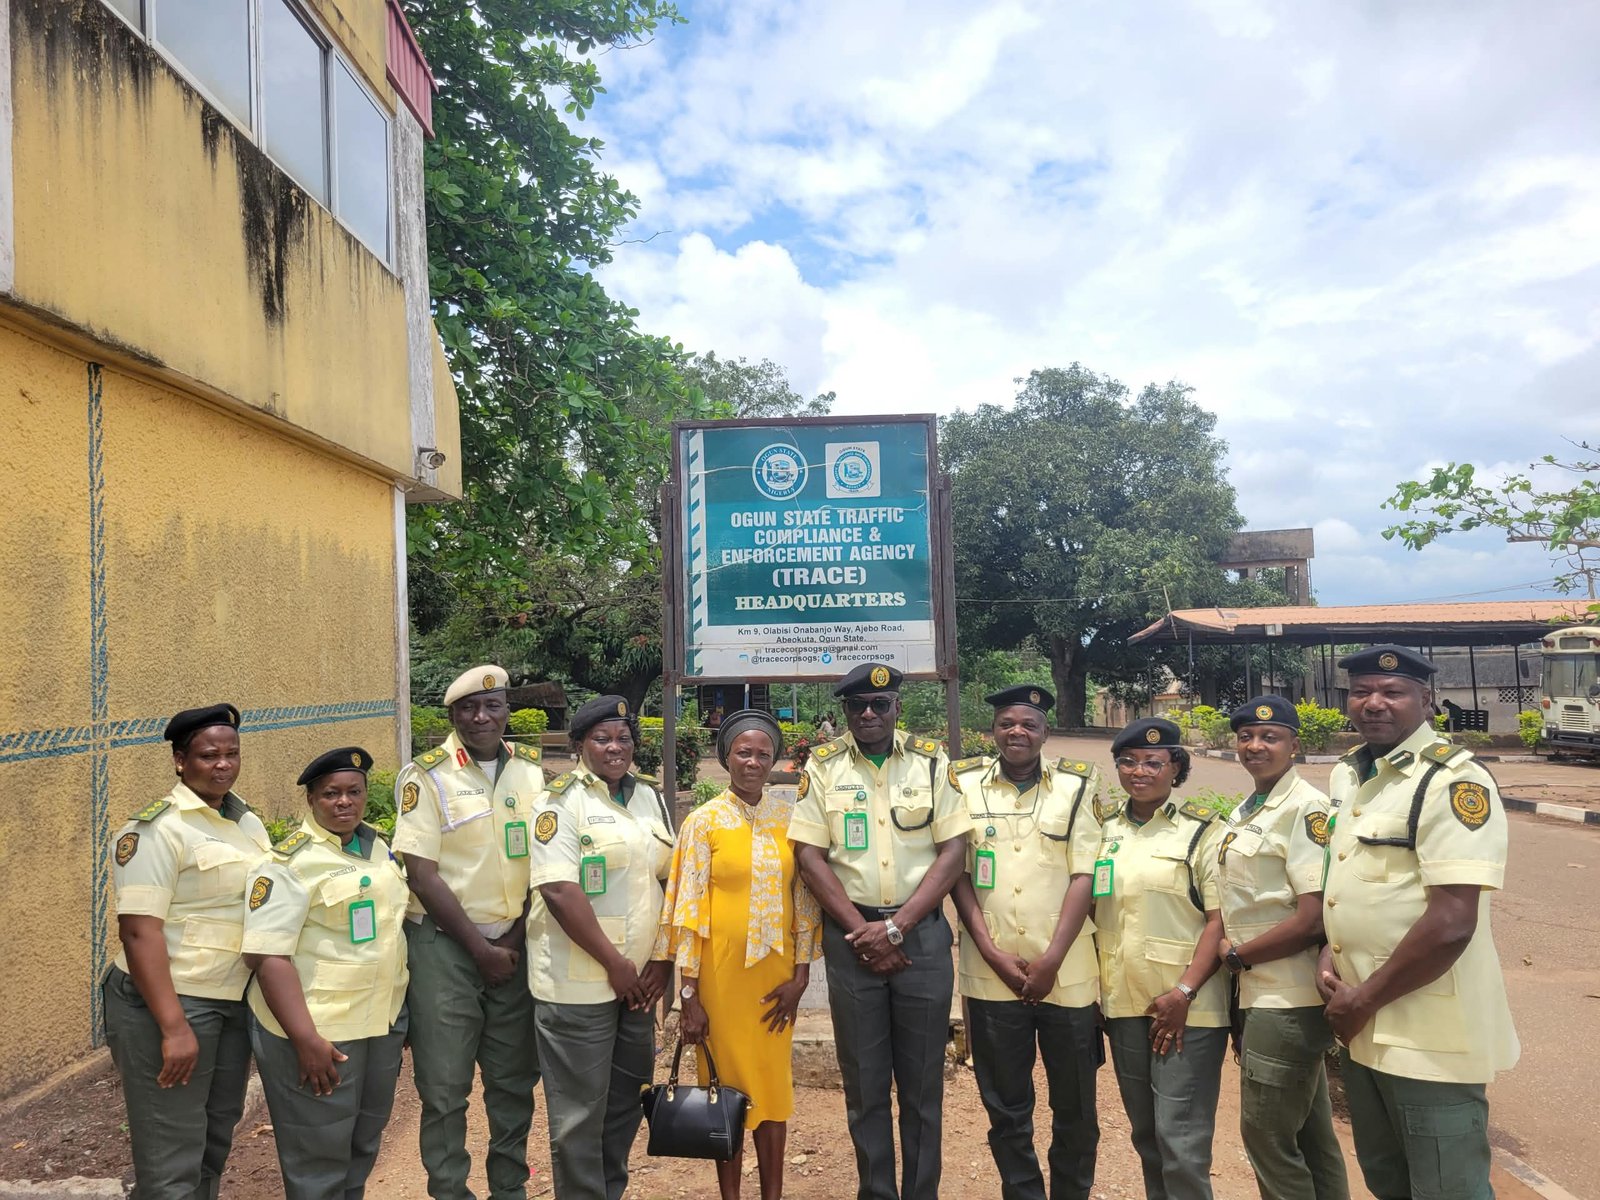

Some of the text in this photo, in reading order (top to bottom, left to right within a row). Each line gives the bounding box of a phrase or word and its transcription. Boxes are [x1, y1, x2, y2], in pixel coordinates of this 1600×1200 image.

[761, 448, 798, 462] OGUN STATE
[766, 487, 796, 496] NIGERIA
[731, 506, 905, 528] OGUN STATE TRAFFIC
[754, 526, 882, 546] COMPLIANCE &
[721, 543, 916, 565] ENFORCEMENT AGENCY
[772, 566, 867, 588] (TRACE)
[735, 592, 907, 611] HEADQUARTERS
[738, 623, 905, 636] Km 9, Olabisi Onabanjo Way, Ajebo Road,
[776, 635, 817, 644] Abeokuta,
[819, 634, 841, 644] Ogun
